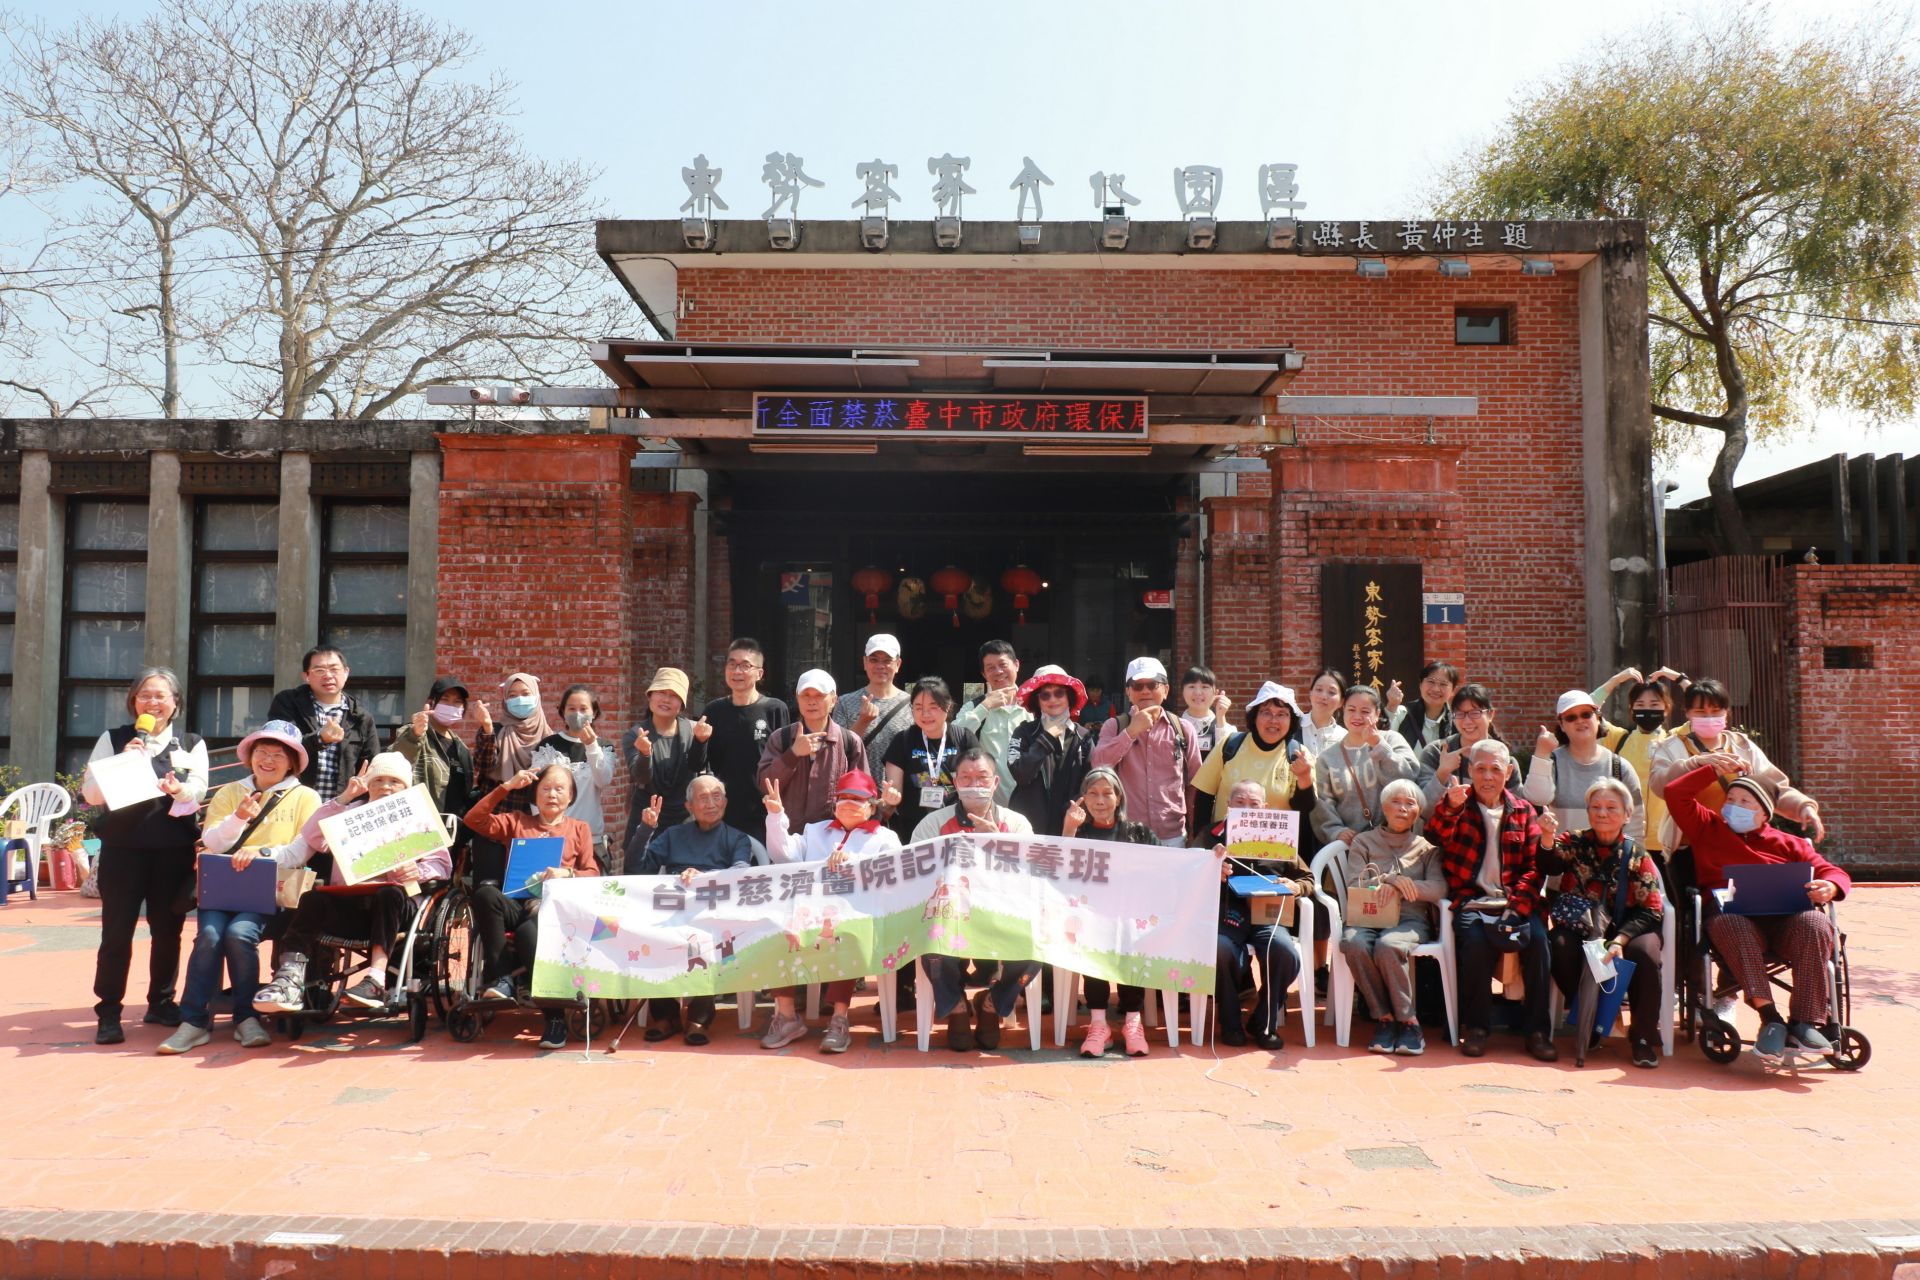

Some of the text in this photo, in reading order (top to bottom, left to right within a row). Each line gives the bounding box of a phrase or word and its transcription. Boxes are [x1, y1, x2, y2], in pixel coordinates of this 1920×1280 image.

[1440, 606, 1451, 623] 1
[344, 796, 408, 826] 台中慈濟醫院
[348, 806, 413, 838] 記憶保養班
[1240, 819, 1289, 830] 記憶保養班
[652, 835, 1111, 911] 台中慈濟醫院記憶保養班
